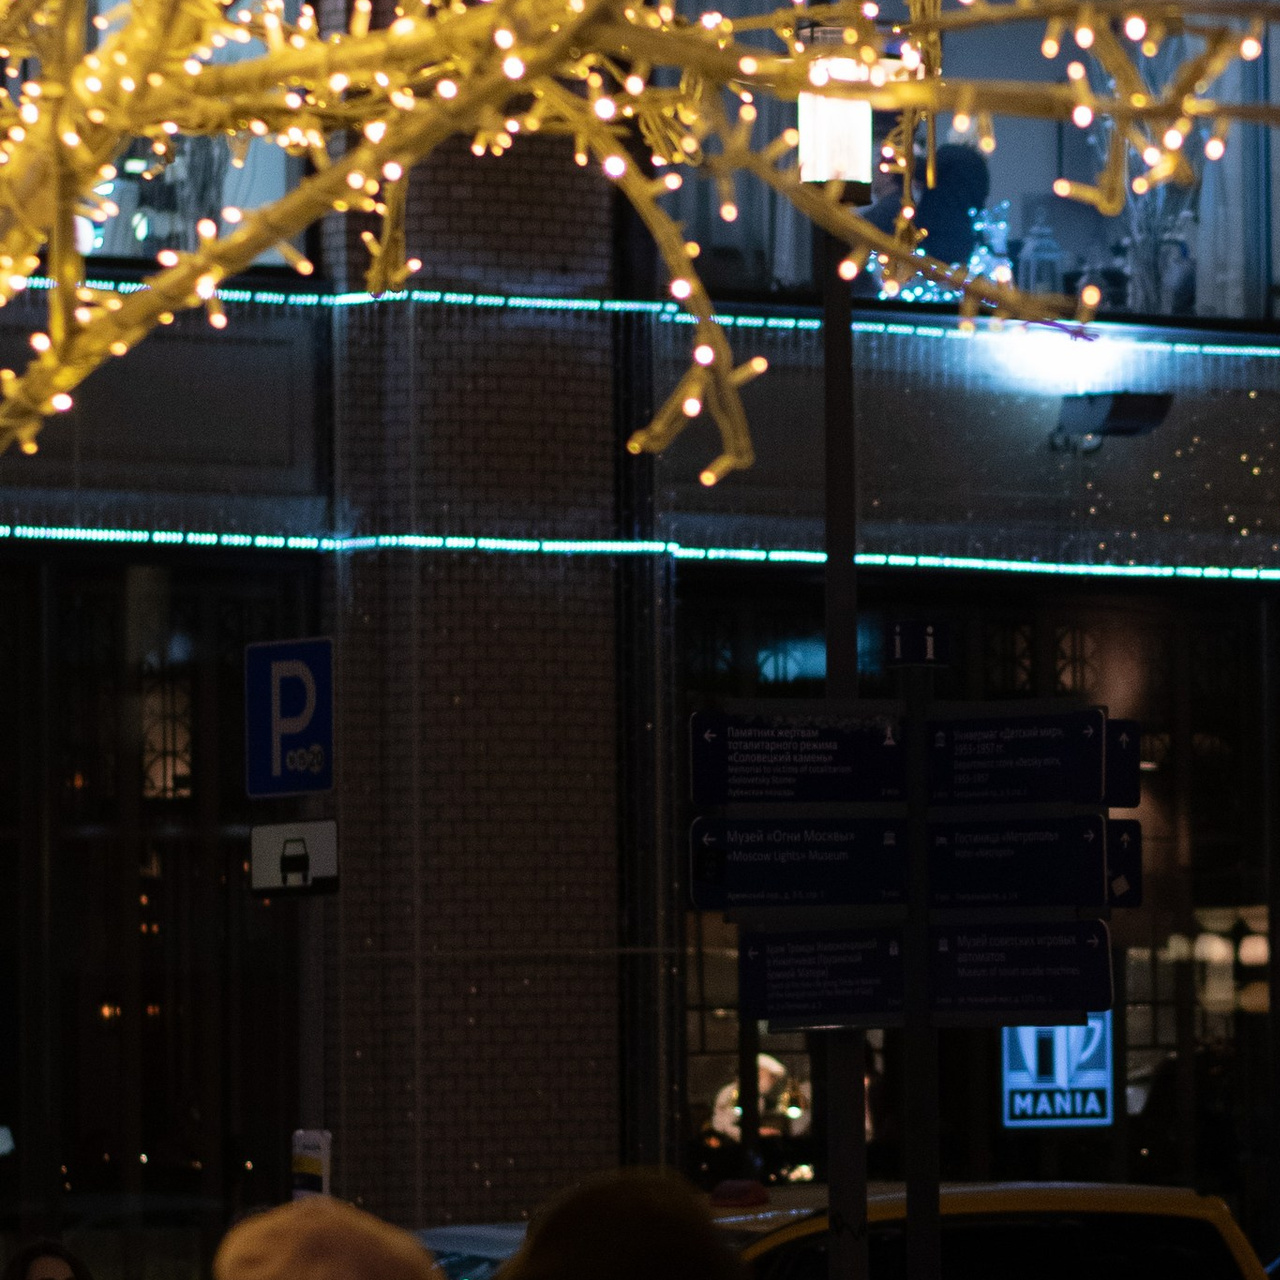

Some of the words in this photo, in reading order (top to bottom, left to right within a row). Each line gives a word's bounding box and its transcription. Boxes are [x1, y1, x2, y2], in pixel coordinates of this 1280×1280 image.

[270, 660, 317, 777] P
[727, 726, 776, 738] Памятник
[776, 728, 819, 740] жертвам
[727, 740, 799, 752] тоталитарного
[800, 740, 838, 752] режима
[727, 752, 791, 764] «Соловецкий
[793, 753, 834, 763] камень»
[726, 830, 764, 845] Музей
[766, 829, 801, 843] «Огни
[803, 829, 856, 842] Москвы»
[726, 851, 771, 862] «Moscow
[773, 851, 807, 863] Lights»
[808, 850, 848, 861] Museum
[1013, 1091, 1102, 1116] MANIA
